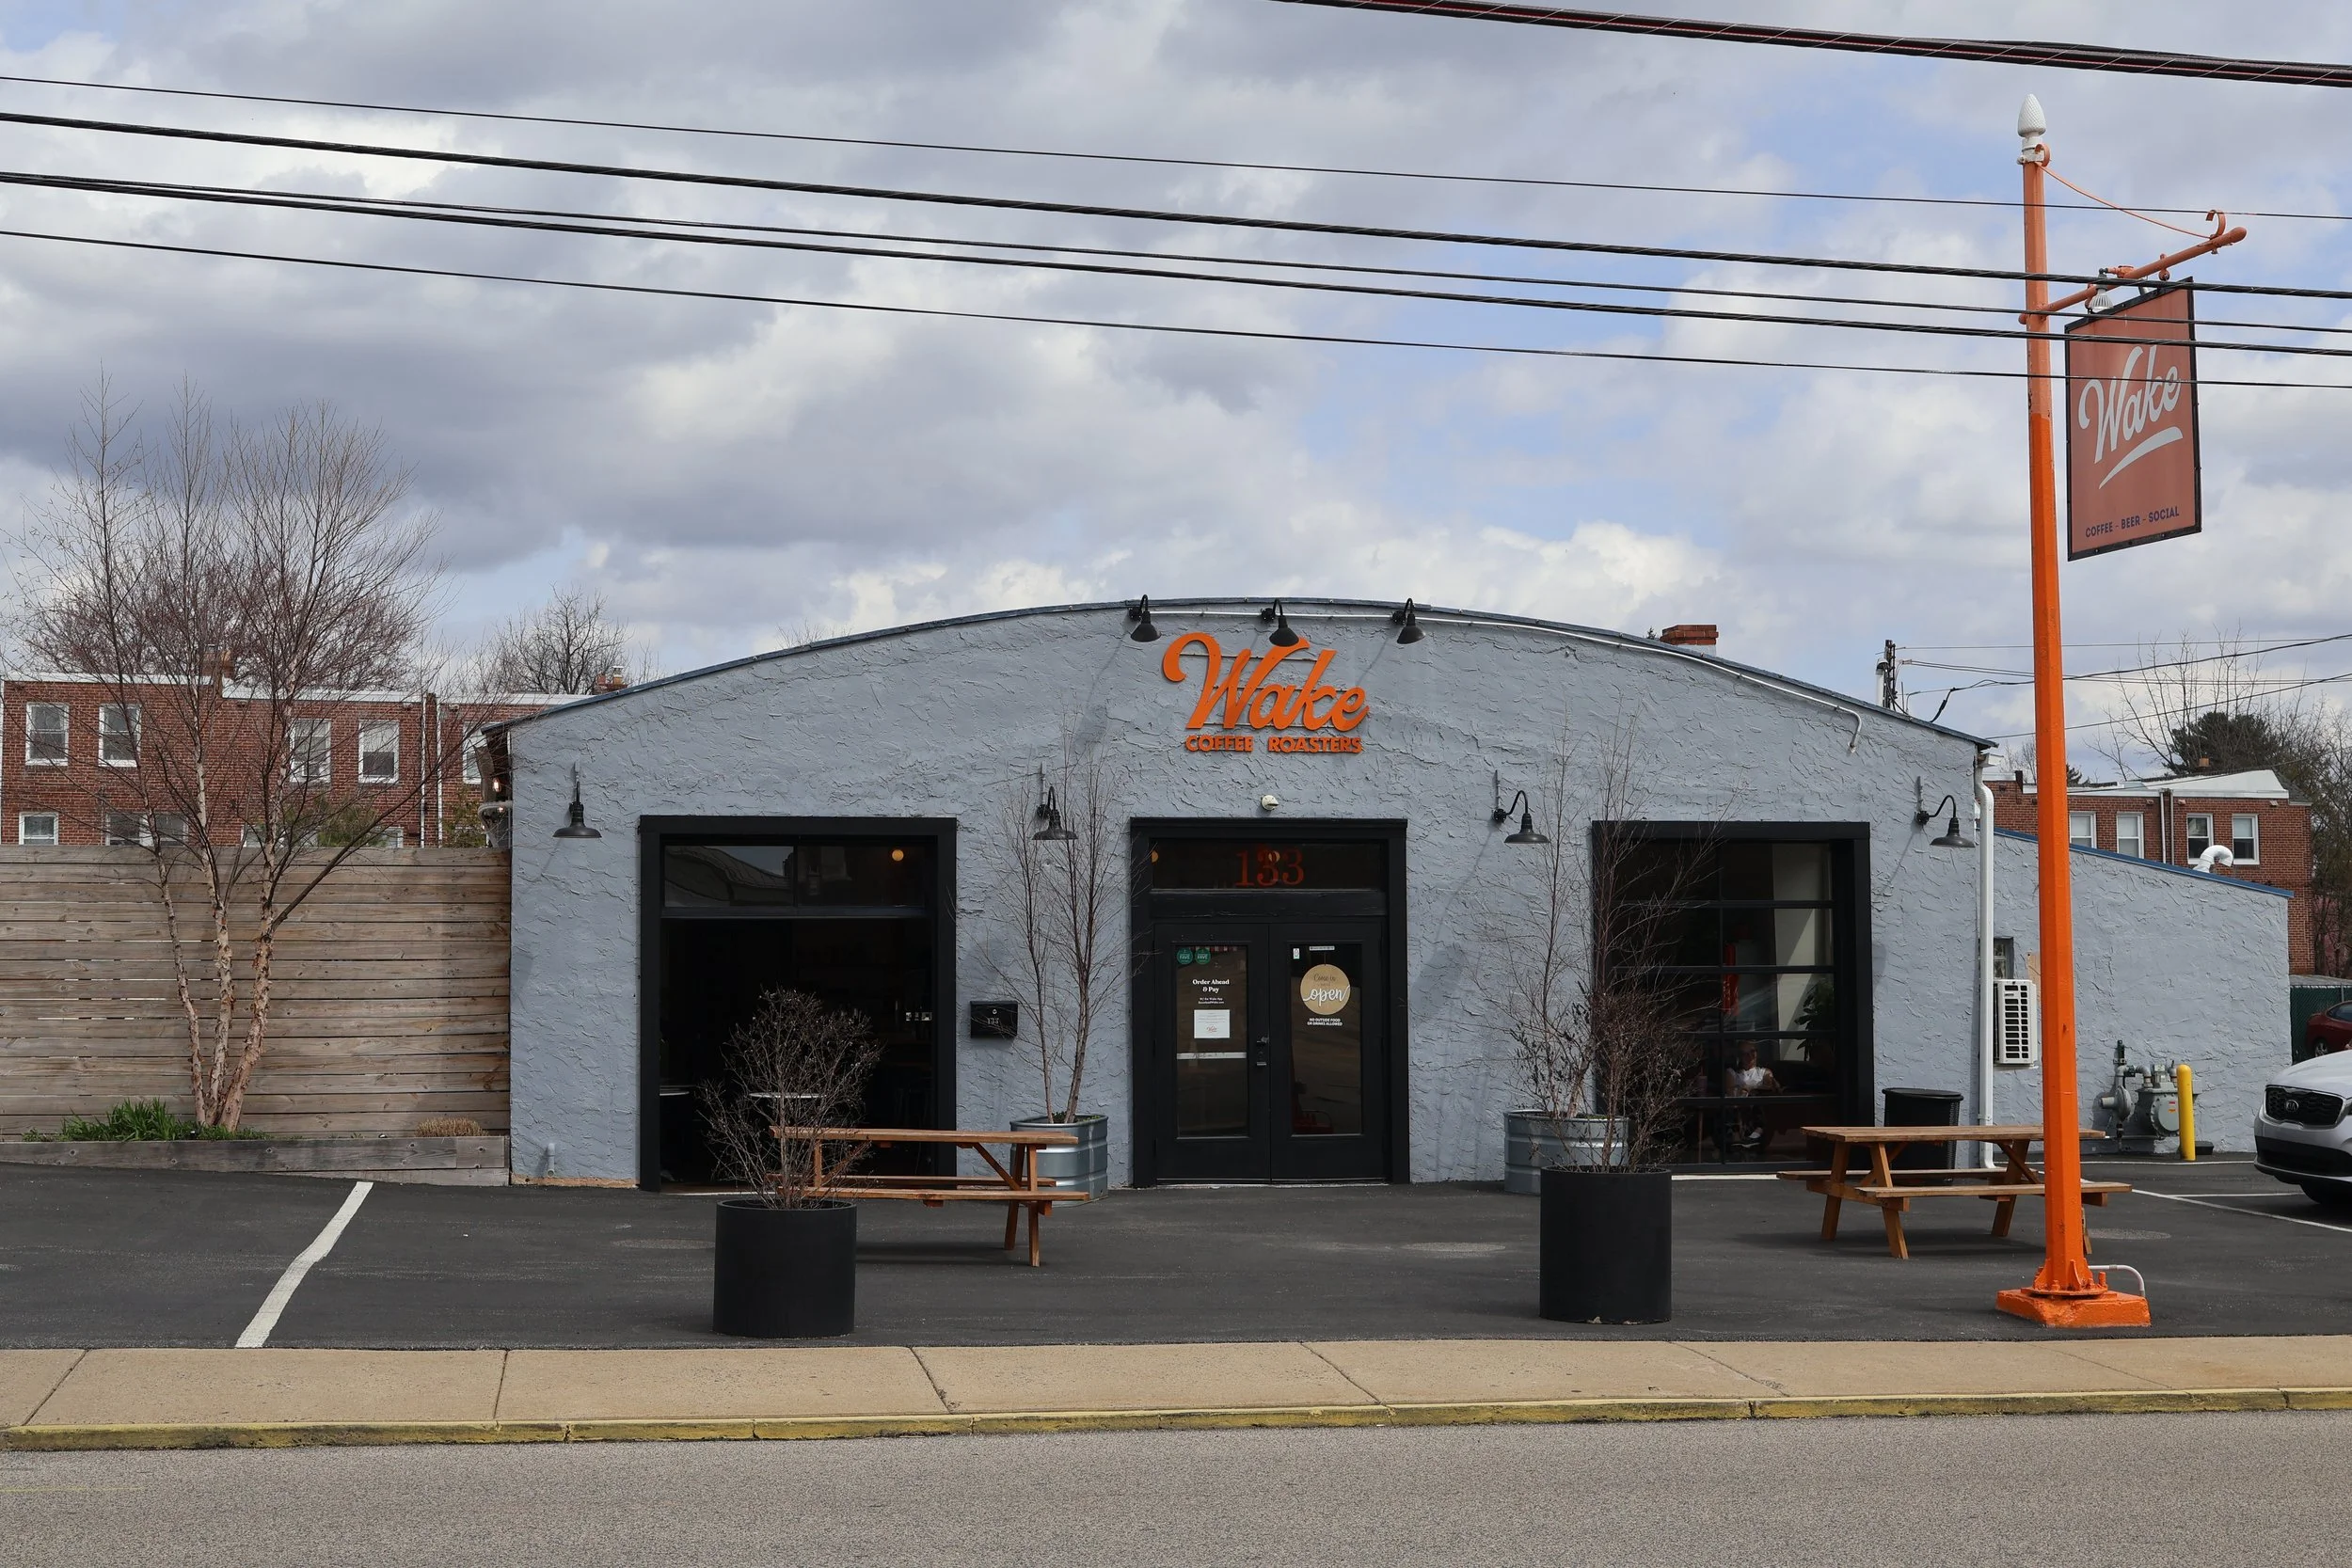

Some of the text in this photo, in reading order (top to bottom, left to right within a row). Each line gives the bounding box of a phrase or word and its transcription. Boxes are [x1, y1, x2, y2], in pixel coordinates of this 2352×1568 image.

[2077, 345, 2182, 464] Wake
[2085, 522, 2113, 538] COFFEE
[2121, 515, 2140, 530] BEER
[2148, 506, 2180, 523] SOCIAL
[1163, 632, 1370, 732] Wake
[1184, 735, 1362, 753] COFFEE ROASTERS
[1235, 847, 1306, 888] 133
[1303, 985, 1350, 1006] open
